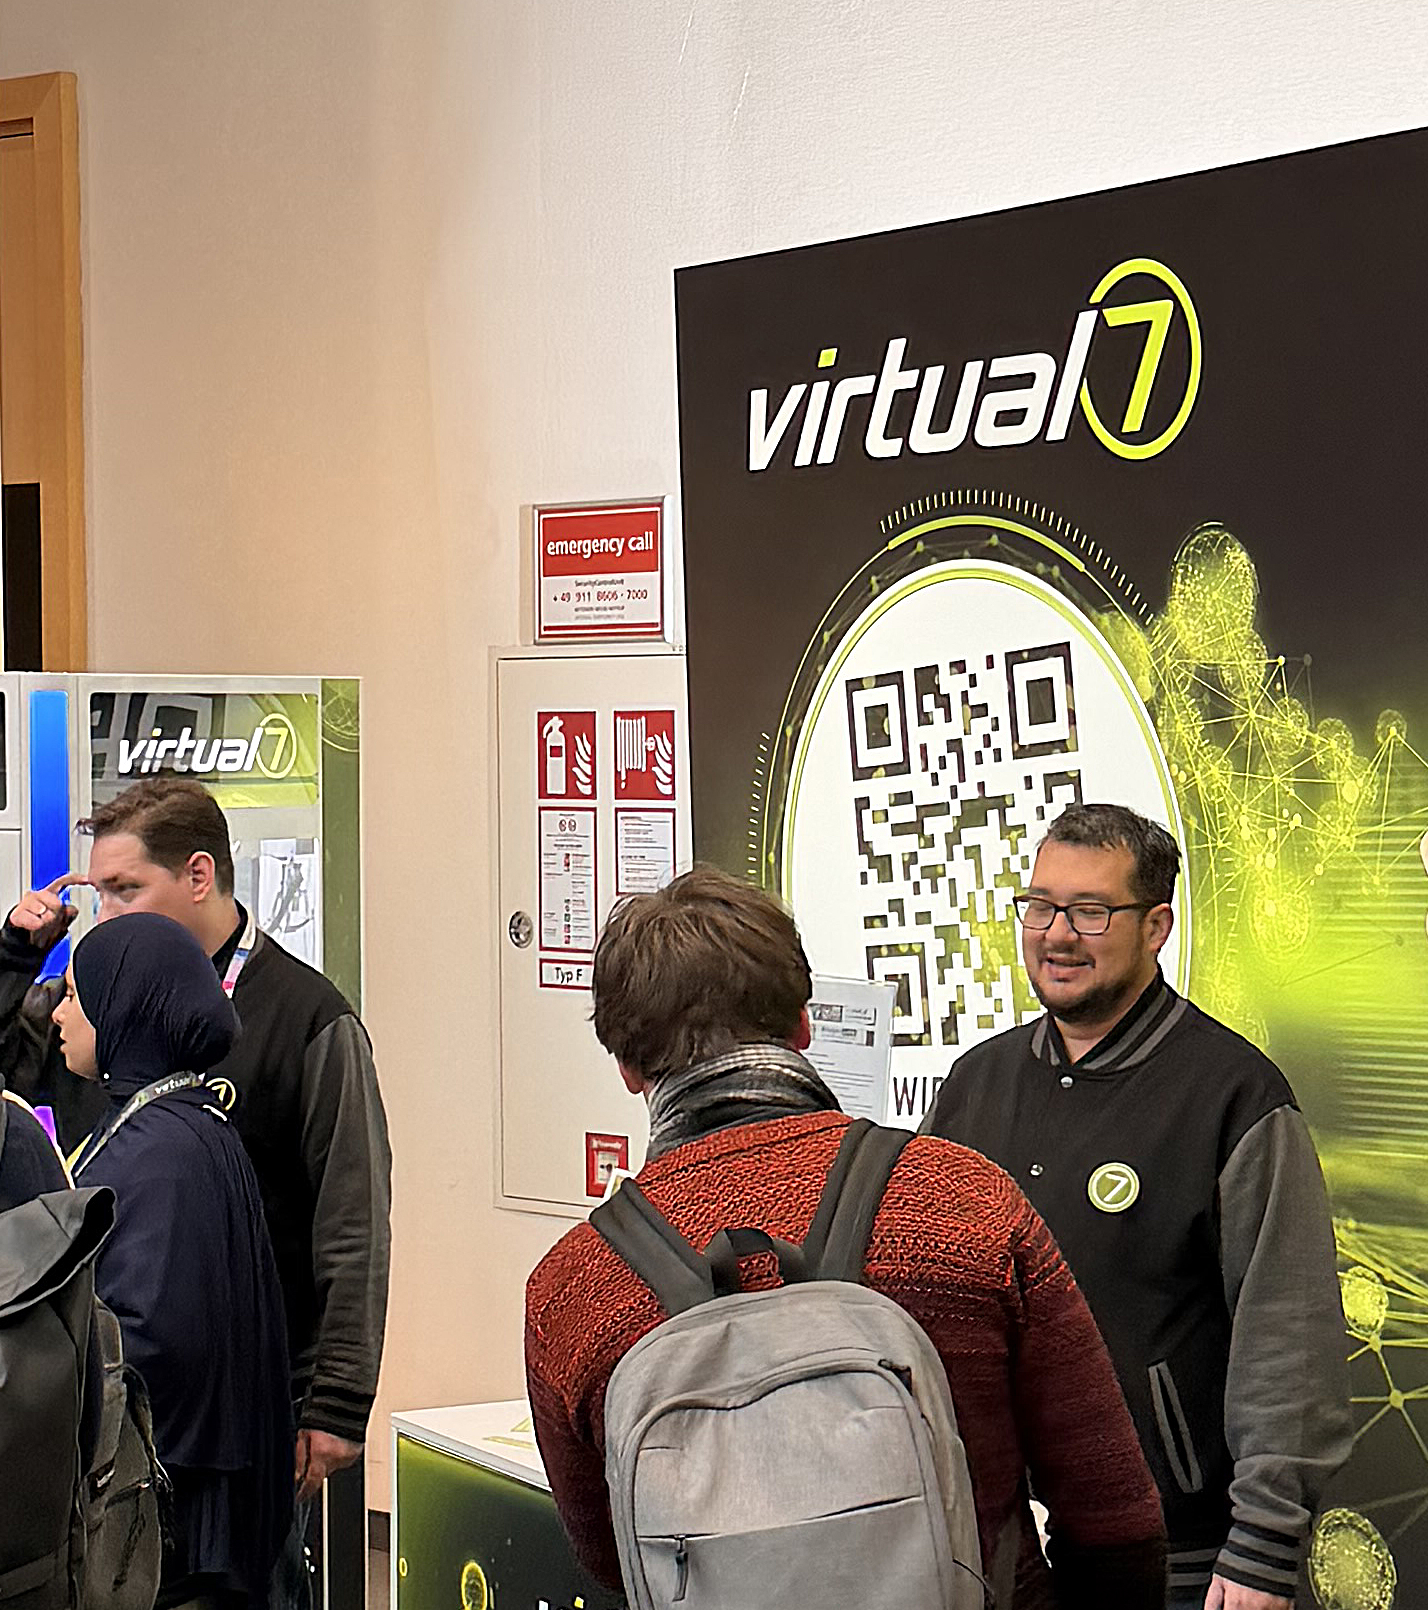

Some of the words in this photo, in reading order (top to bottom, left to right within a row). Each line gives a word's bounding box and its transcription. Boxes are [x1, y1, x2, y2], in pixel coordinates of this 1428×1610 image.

[748, 257, 1202, 472] virtual7
[547, 537, 625, 559] emergency
[628, 531, 653, 551] call
[555, 966, 573, 983] Typ
[576, 968, 583, 981] F
